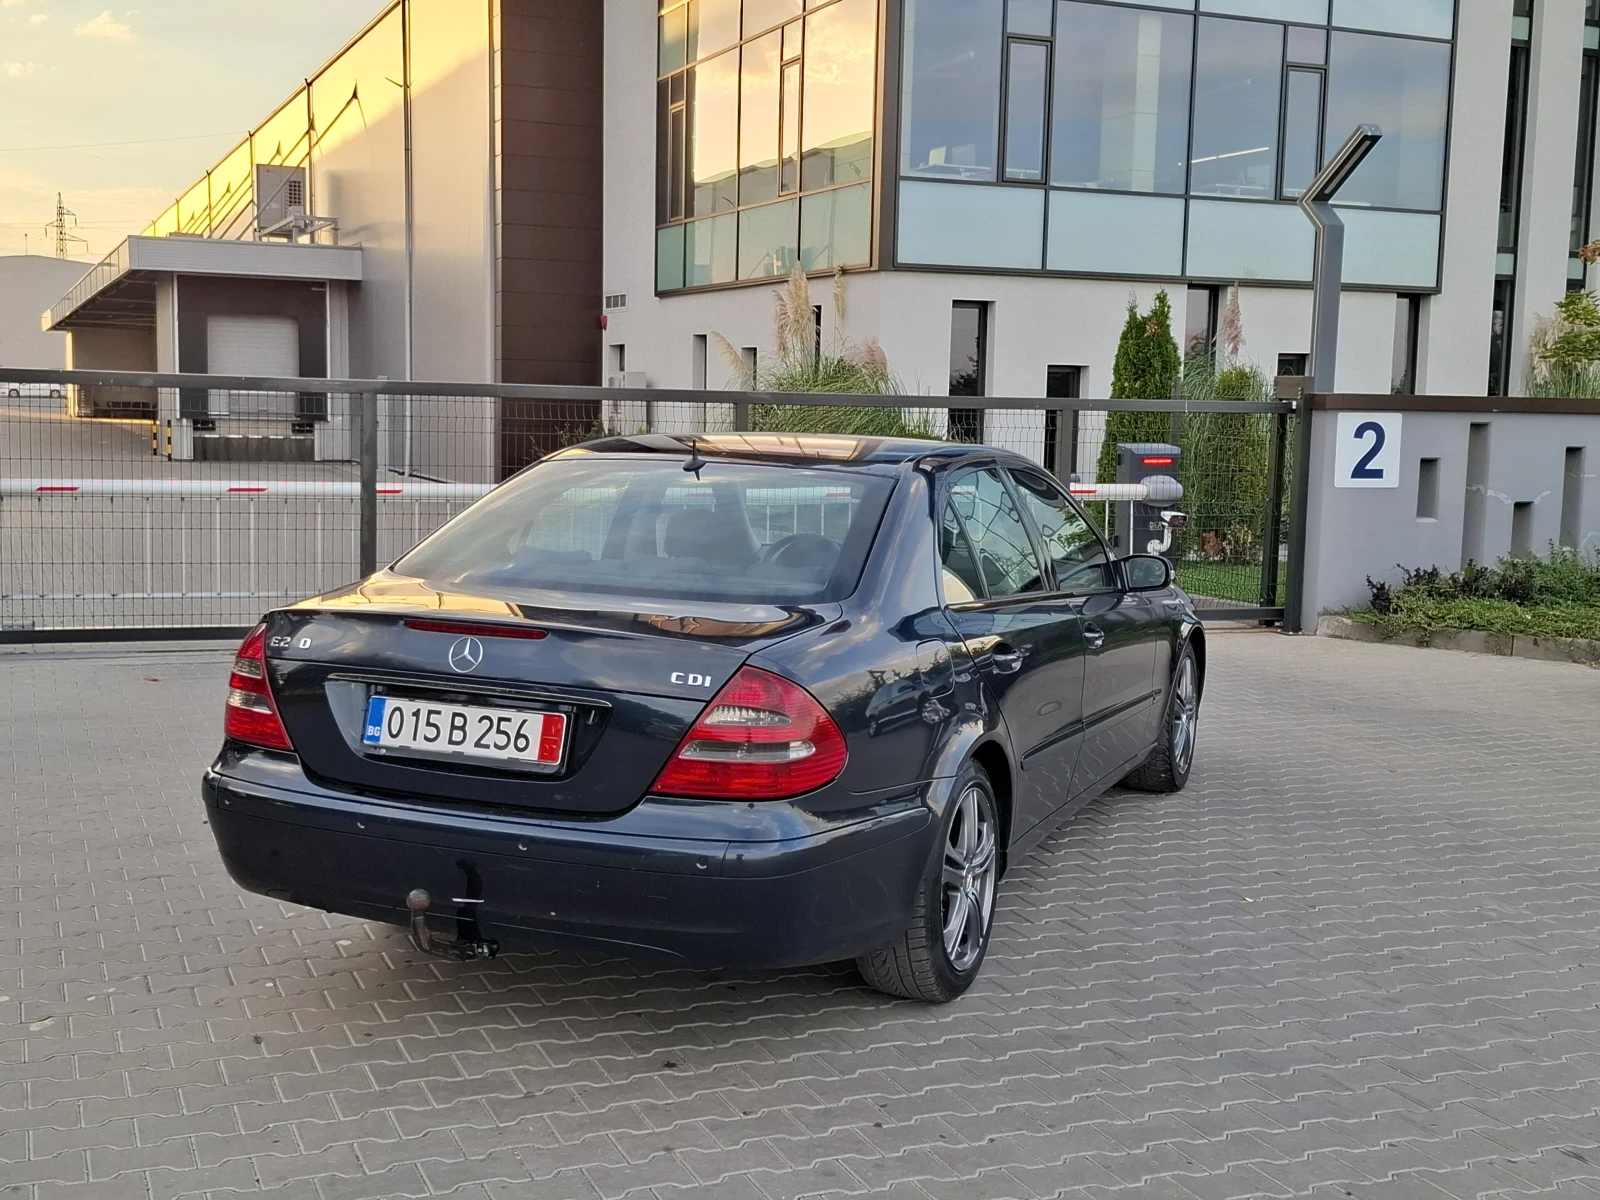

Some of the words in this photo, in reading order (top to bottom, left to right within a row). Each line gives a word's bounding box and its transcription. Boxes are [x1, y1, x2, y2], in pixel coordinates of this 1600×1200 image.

[1350, 420, 1386, 480] 2
[670, 671, 712, 688] CDI
[366, 724, 381, 737] BG
